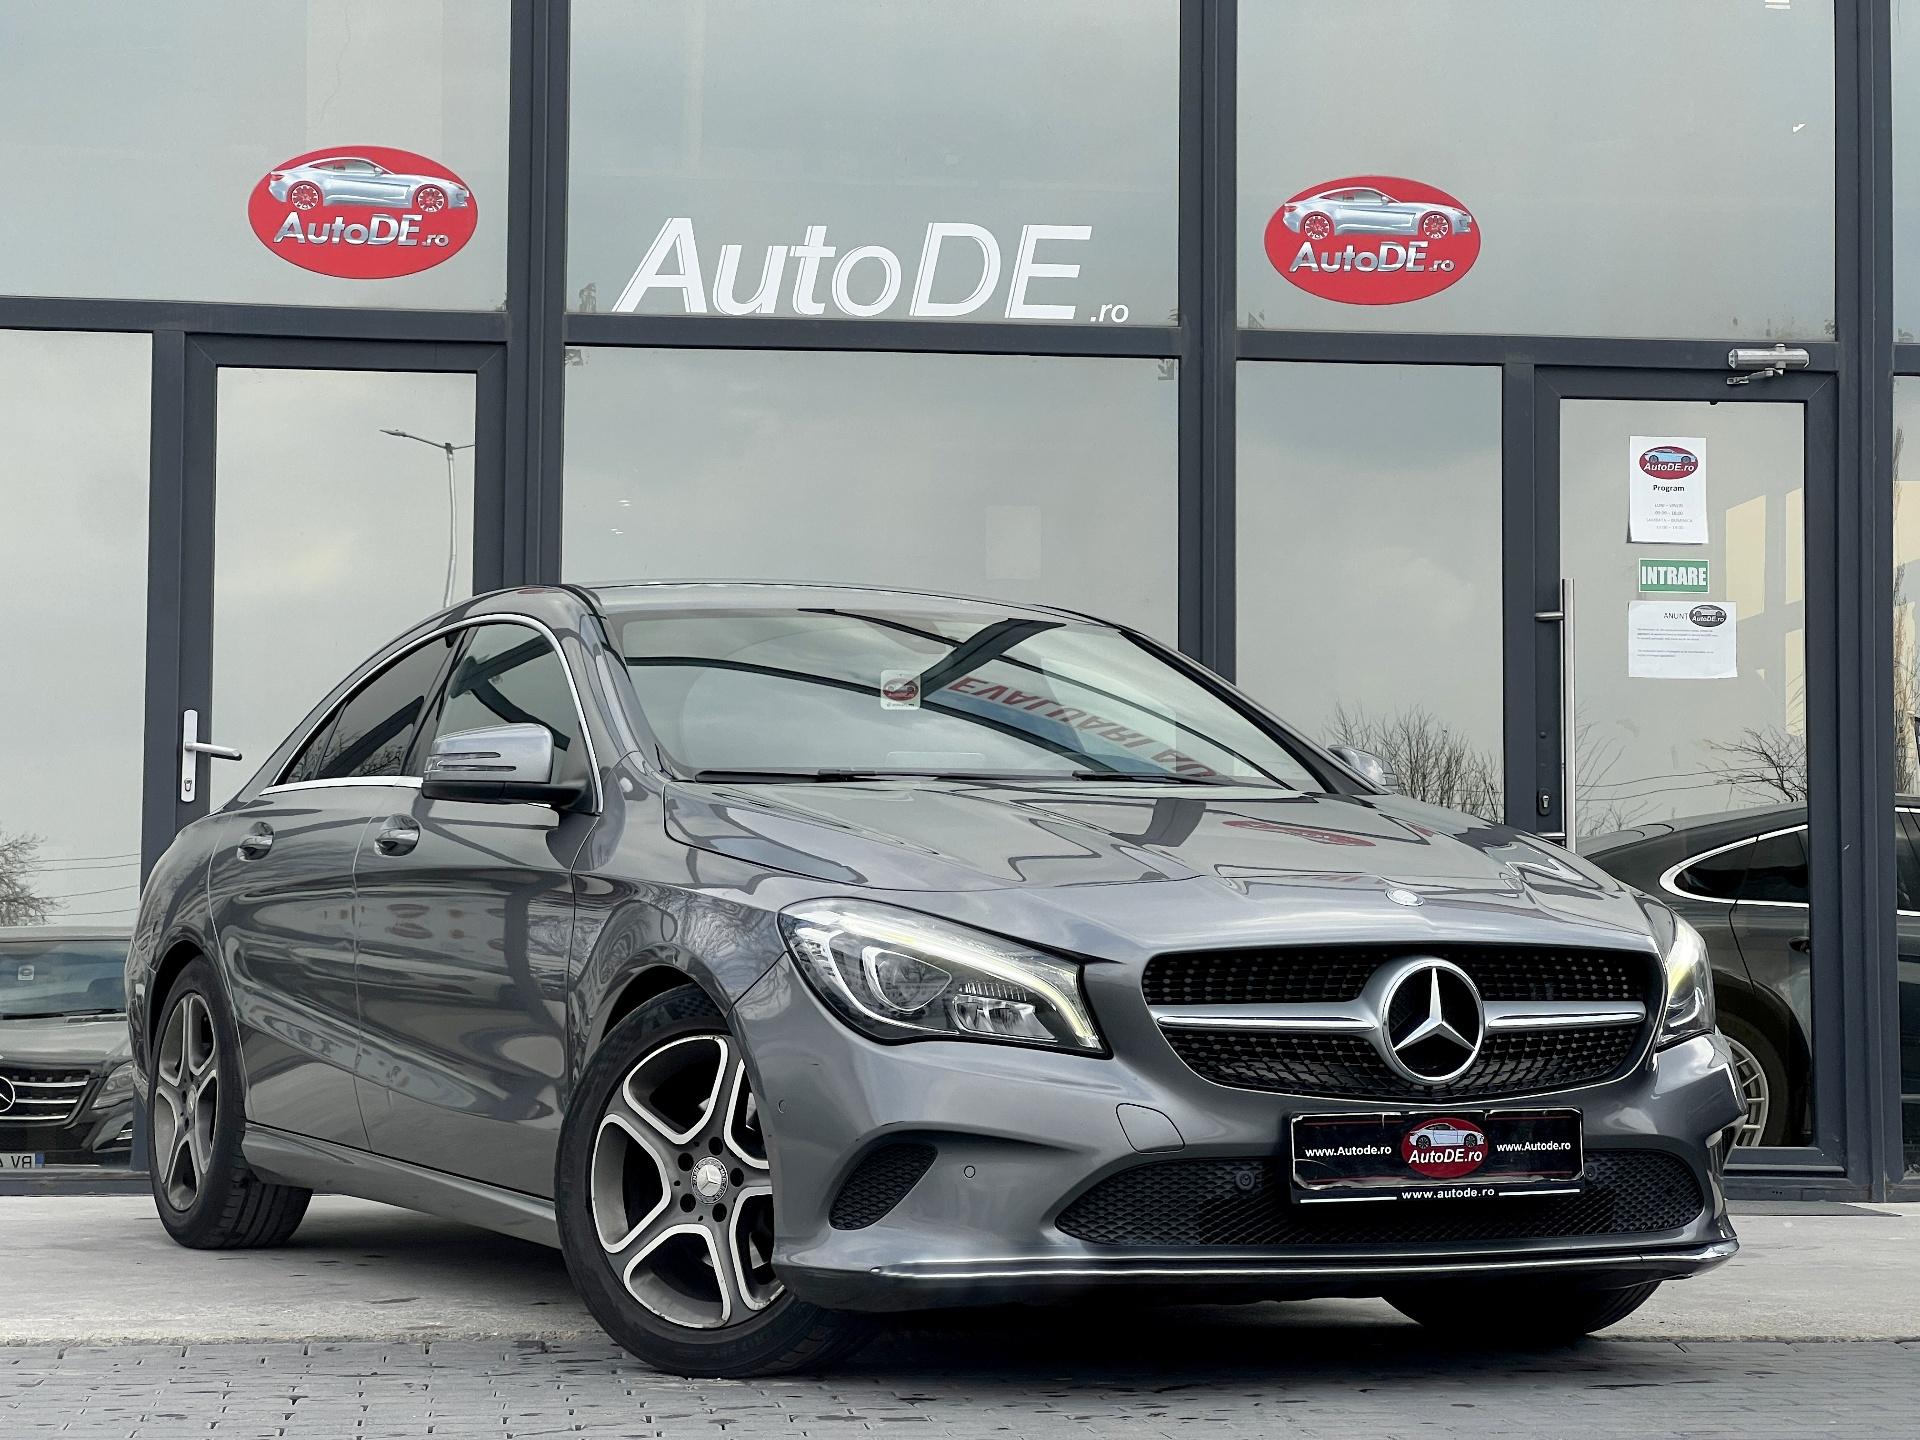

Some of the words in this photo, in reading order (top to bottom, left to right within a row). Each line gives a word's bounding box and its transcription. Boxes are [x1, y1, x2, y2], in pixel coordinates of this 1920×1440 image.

[273, 211, 450, 248] AutoDE.ro
[1290, 240, 1455, 274] AutoDE.ro
[1643, 462, 1695, 473] AutoDE.ro
[1652, 484, 1685, 493] Program
[1641, 565, 1707, 586] INTRARE
[1305, 1145, 1392, 1158] www.Autode.ro
[1496, 1141, 1572, 1153] www.Autode.ro
[1408, 1148, 1483, 1165] AutoDE.ro
[1401, 1187, 1495, 1199] www.autode.ro
